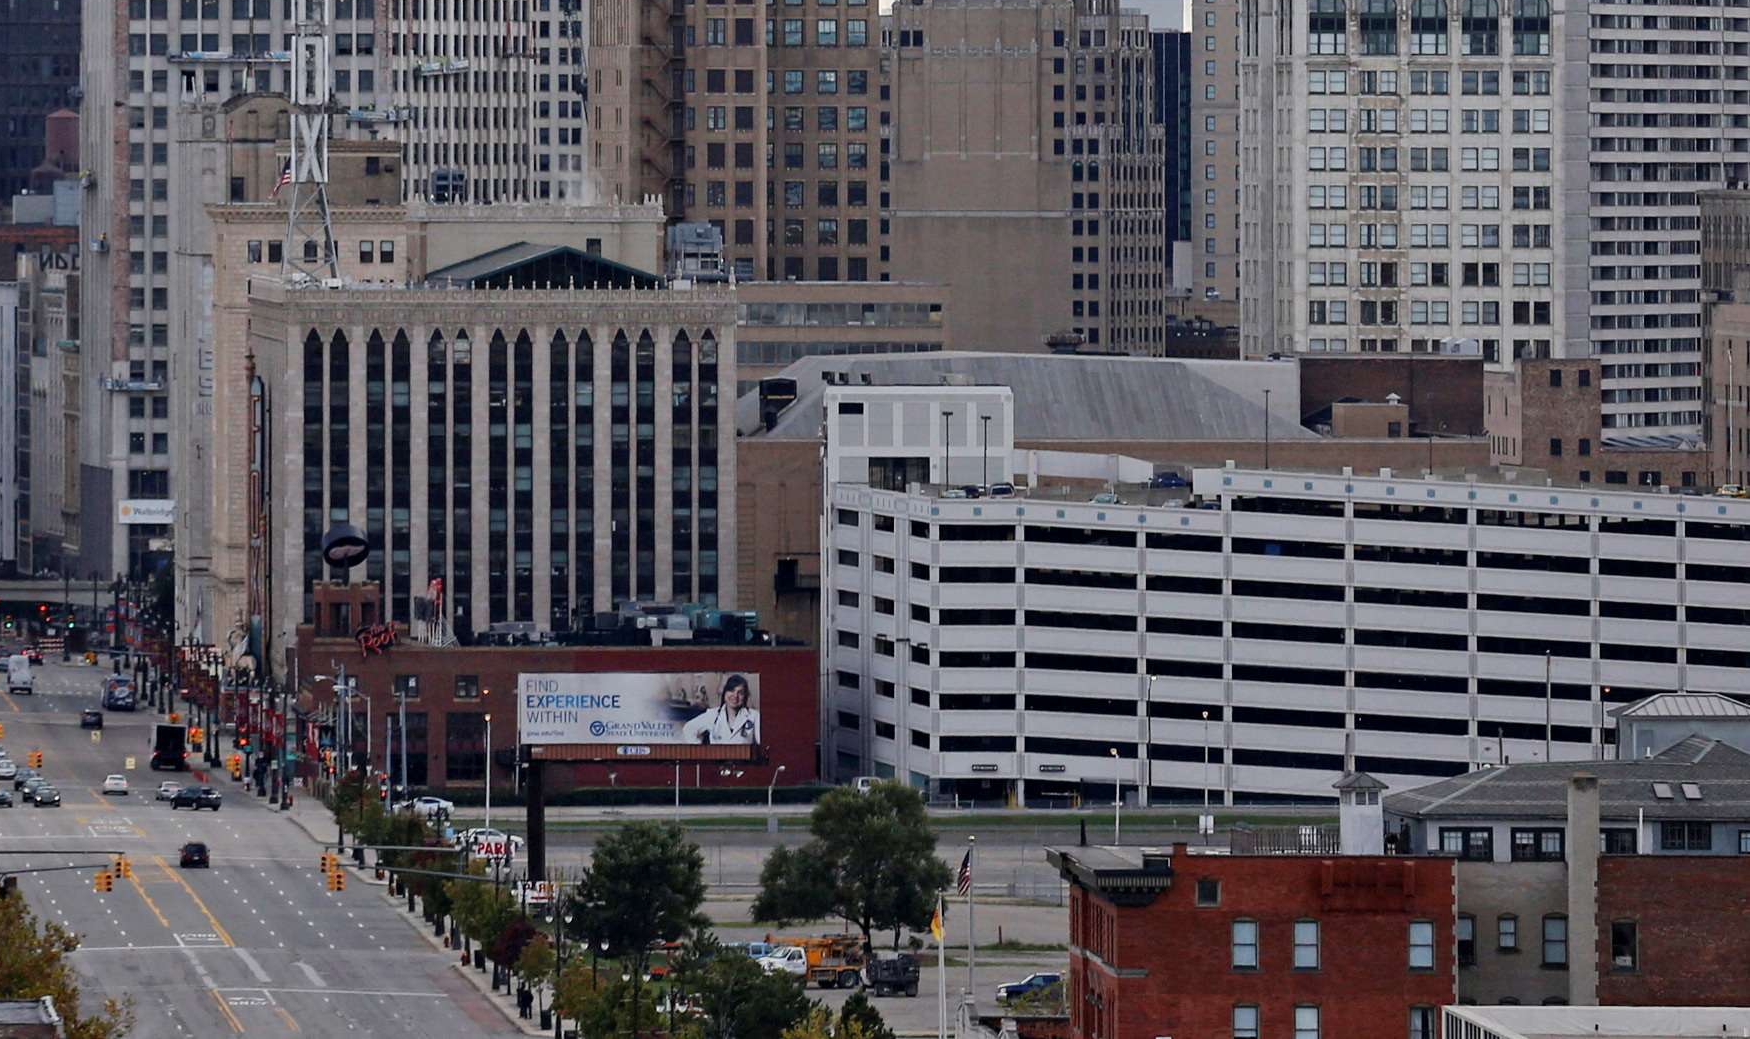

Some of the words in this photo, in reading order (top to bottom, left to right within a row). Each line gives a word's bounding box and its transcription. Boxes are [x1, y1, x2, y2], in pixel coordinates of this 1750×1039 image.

[250, 394, 261, 616] FOX
[526, 679, 558, 692] FIND
[526, 695, 620, 708] EXPERIENCE
[527, 711, 578, 723] WITHIN
[477, 842, 513, 856] PARK
